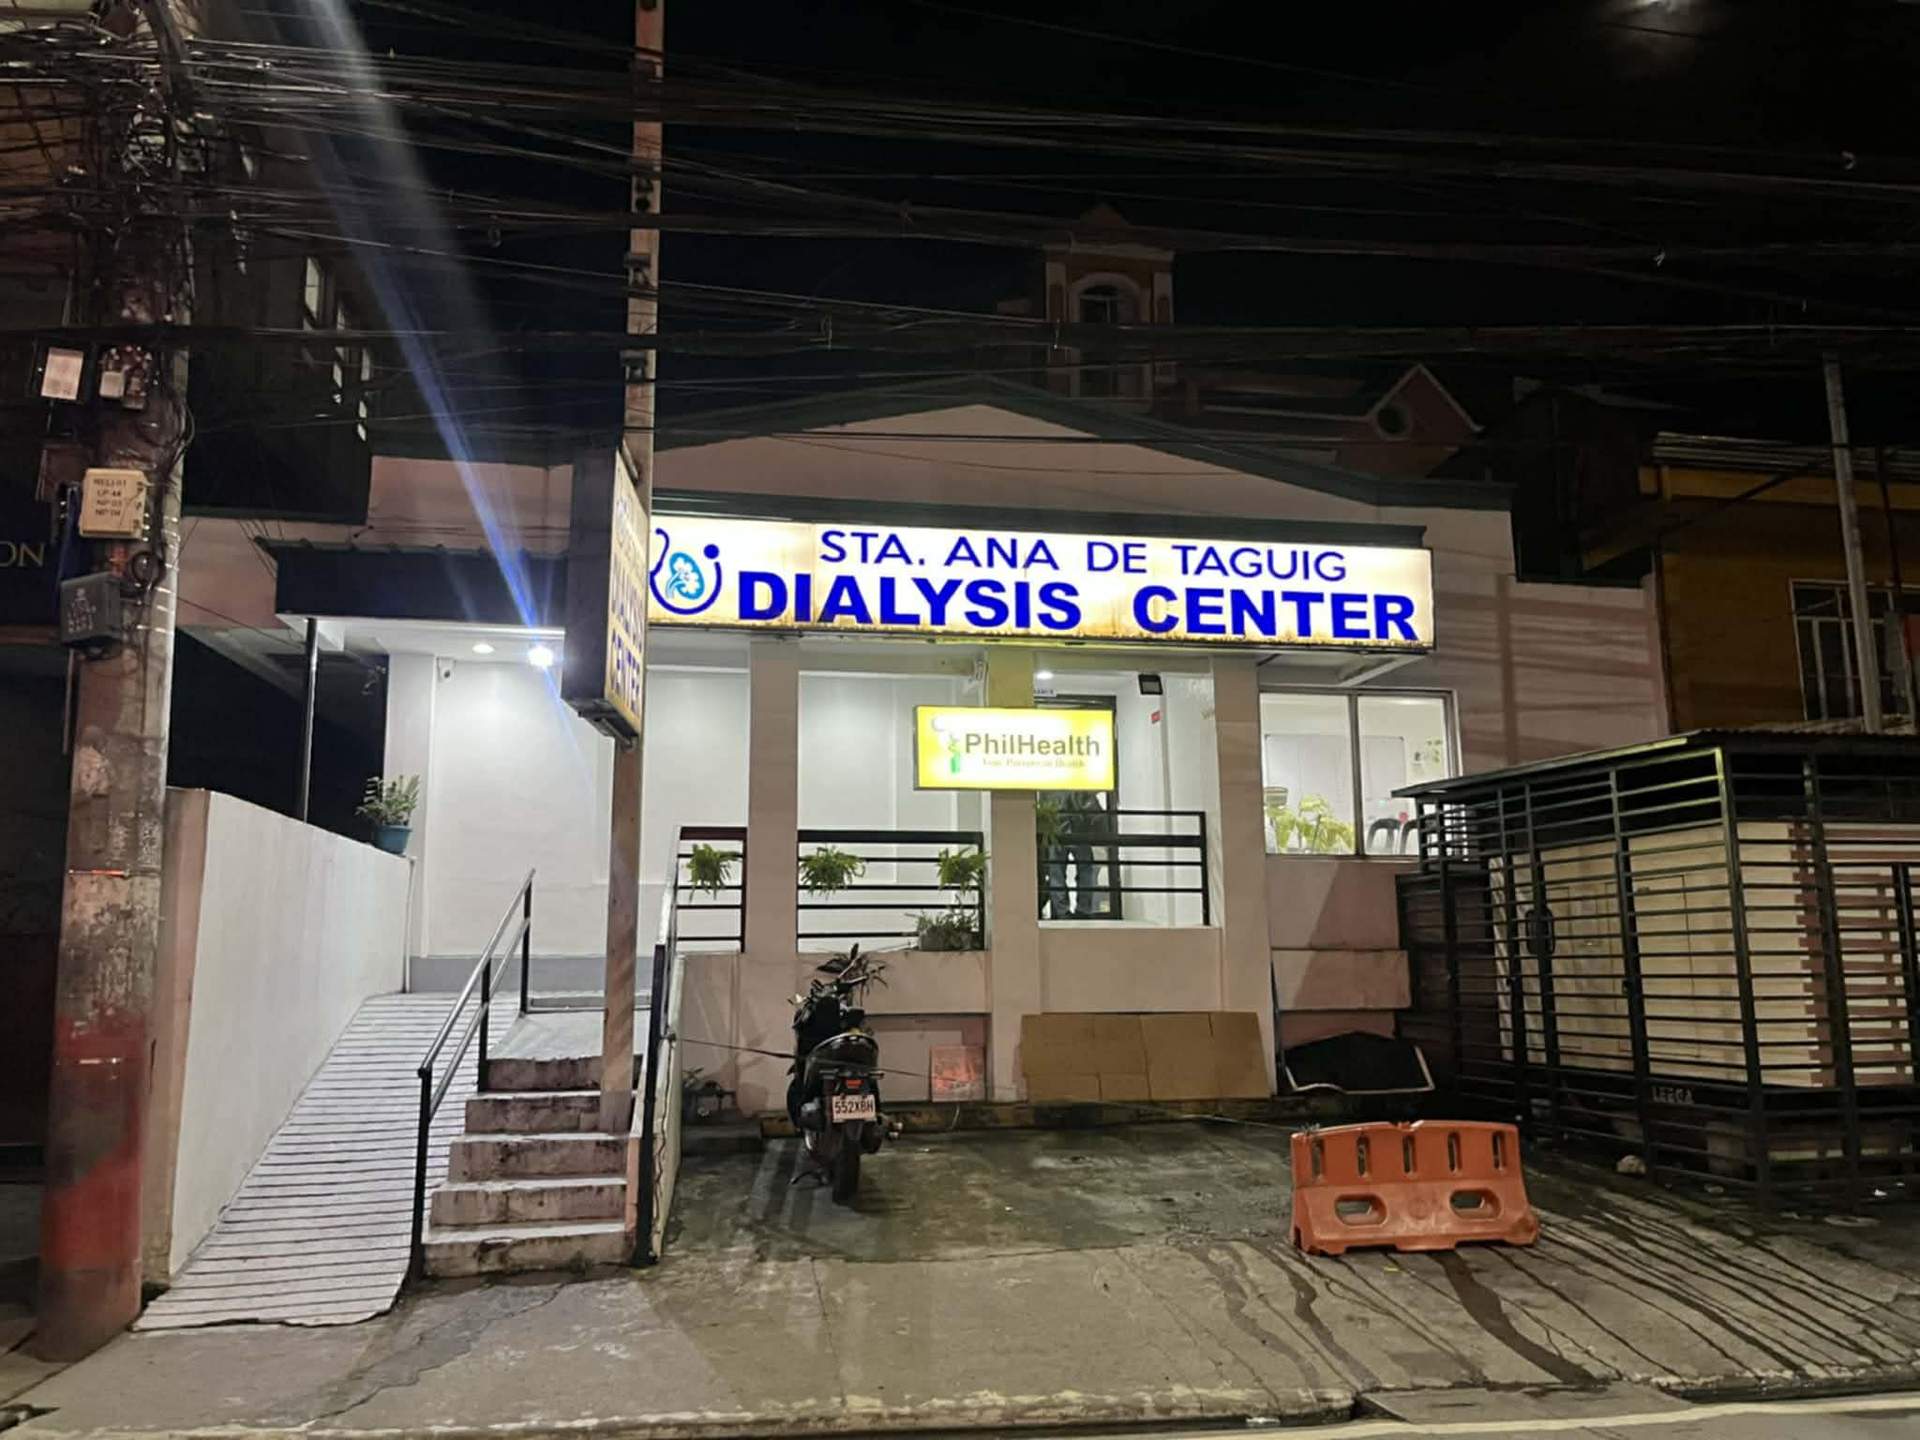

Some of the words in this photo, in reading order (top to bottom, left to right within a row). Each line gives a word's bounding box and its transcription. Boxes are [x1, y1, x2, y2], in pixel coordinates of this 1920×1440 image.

[820, 530, 925, 565] STA.
[944, 536, 1060, 571] ANA
[1087, 541, 1147, 574] DE
[1172, 545, 1346, 582] TAGUIG
[738, 570, 1082, 631] DIALYSIS
[1133, 585, 1419, 641] CENTER
[965, 733, 1100, 756] PhilHealth
[835, 1100, 874, 1114] 552XBH
